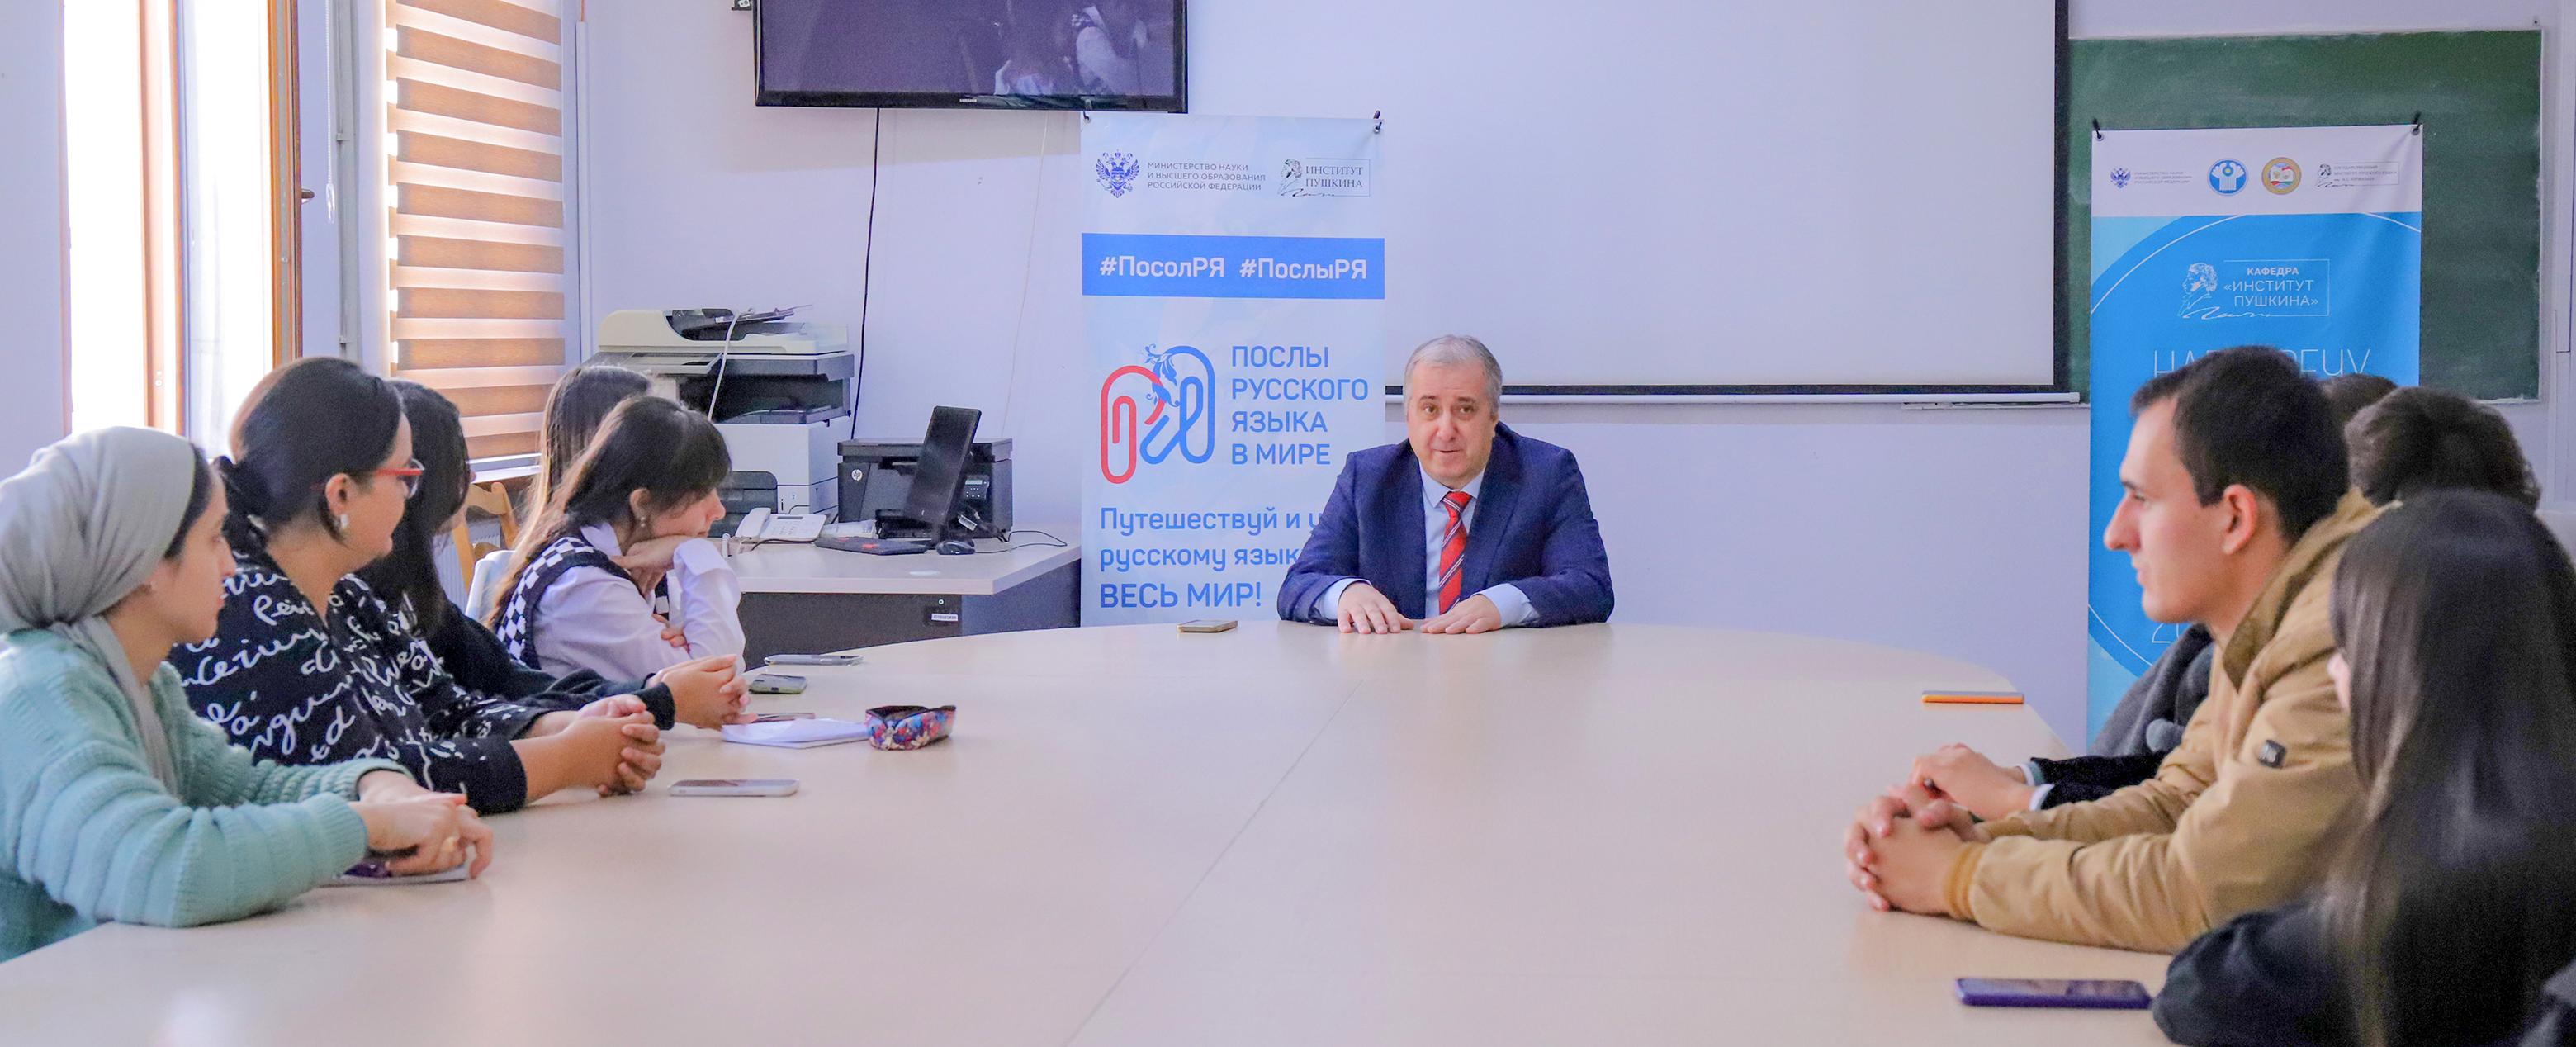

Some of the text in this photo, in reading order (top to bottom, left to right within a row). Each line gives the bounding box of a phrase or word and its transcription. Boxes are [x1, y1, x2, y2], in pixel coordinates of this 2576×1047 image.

[1147, 162, 1217, 171] МИНИСТЕРСТВО
[1305, 165, 1364, 176] ИНСТИТУТ
[1156, 172, 1199, 180] ВЫСШЕГО
[1200, 173, 1266, 182] ОБРАЗОВАНИЯ
[1305, 178, 1363, 188] ПУШКИНА
[1147, 181, 1262, 192] РОССИЙСКОЙ ФЕДЕРАЦИИ
[1100, 255, 1367, 280] #ПосолРЯ #ПослыРЯ
[2247, 267, 2299, 277] КАФЕДРА
[2223, 279, 2314, 291] «ИНСТИТУТ
[2233, 295, 2319, 307] ПУШКИНА»
[1231, 346, 1328, 368] ПОСЛЫ
[1231, 378, 1368, 400] РУССКОГО
[1231, 411, 1328, 433] ЯЗЫКА
[1231, 443, 1331, 465] В МИРЕ
[1101, 507, 1277, 535] Путешествуй
[1286, 513, 1300, 528] и
[1101, 548, 1300, 572] русскому язык
[1101, 581, 1262, 608] ВЕСЬ МИР!
